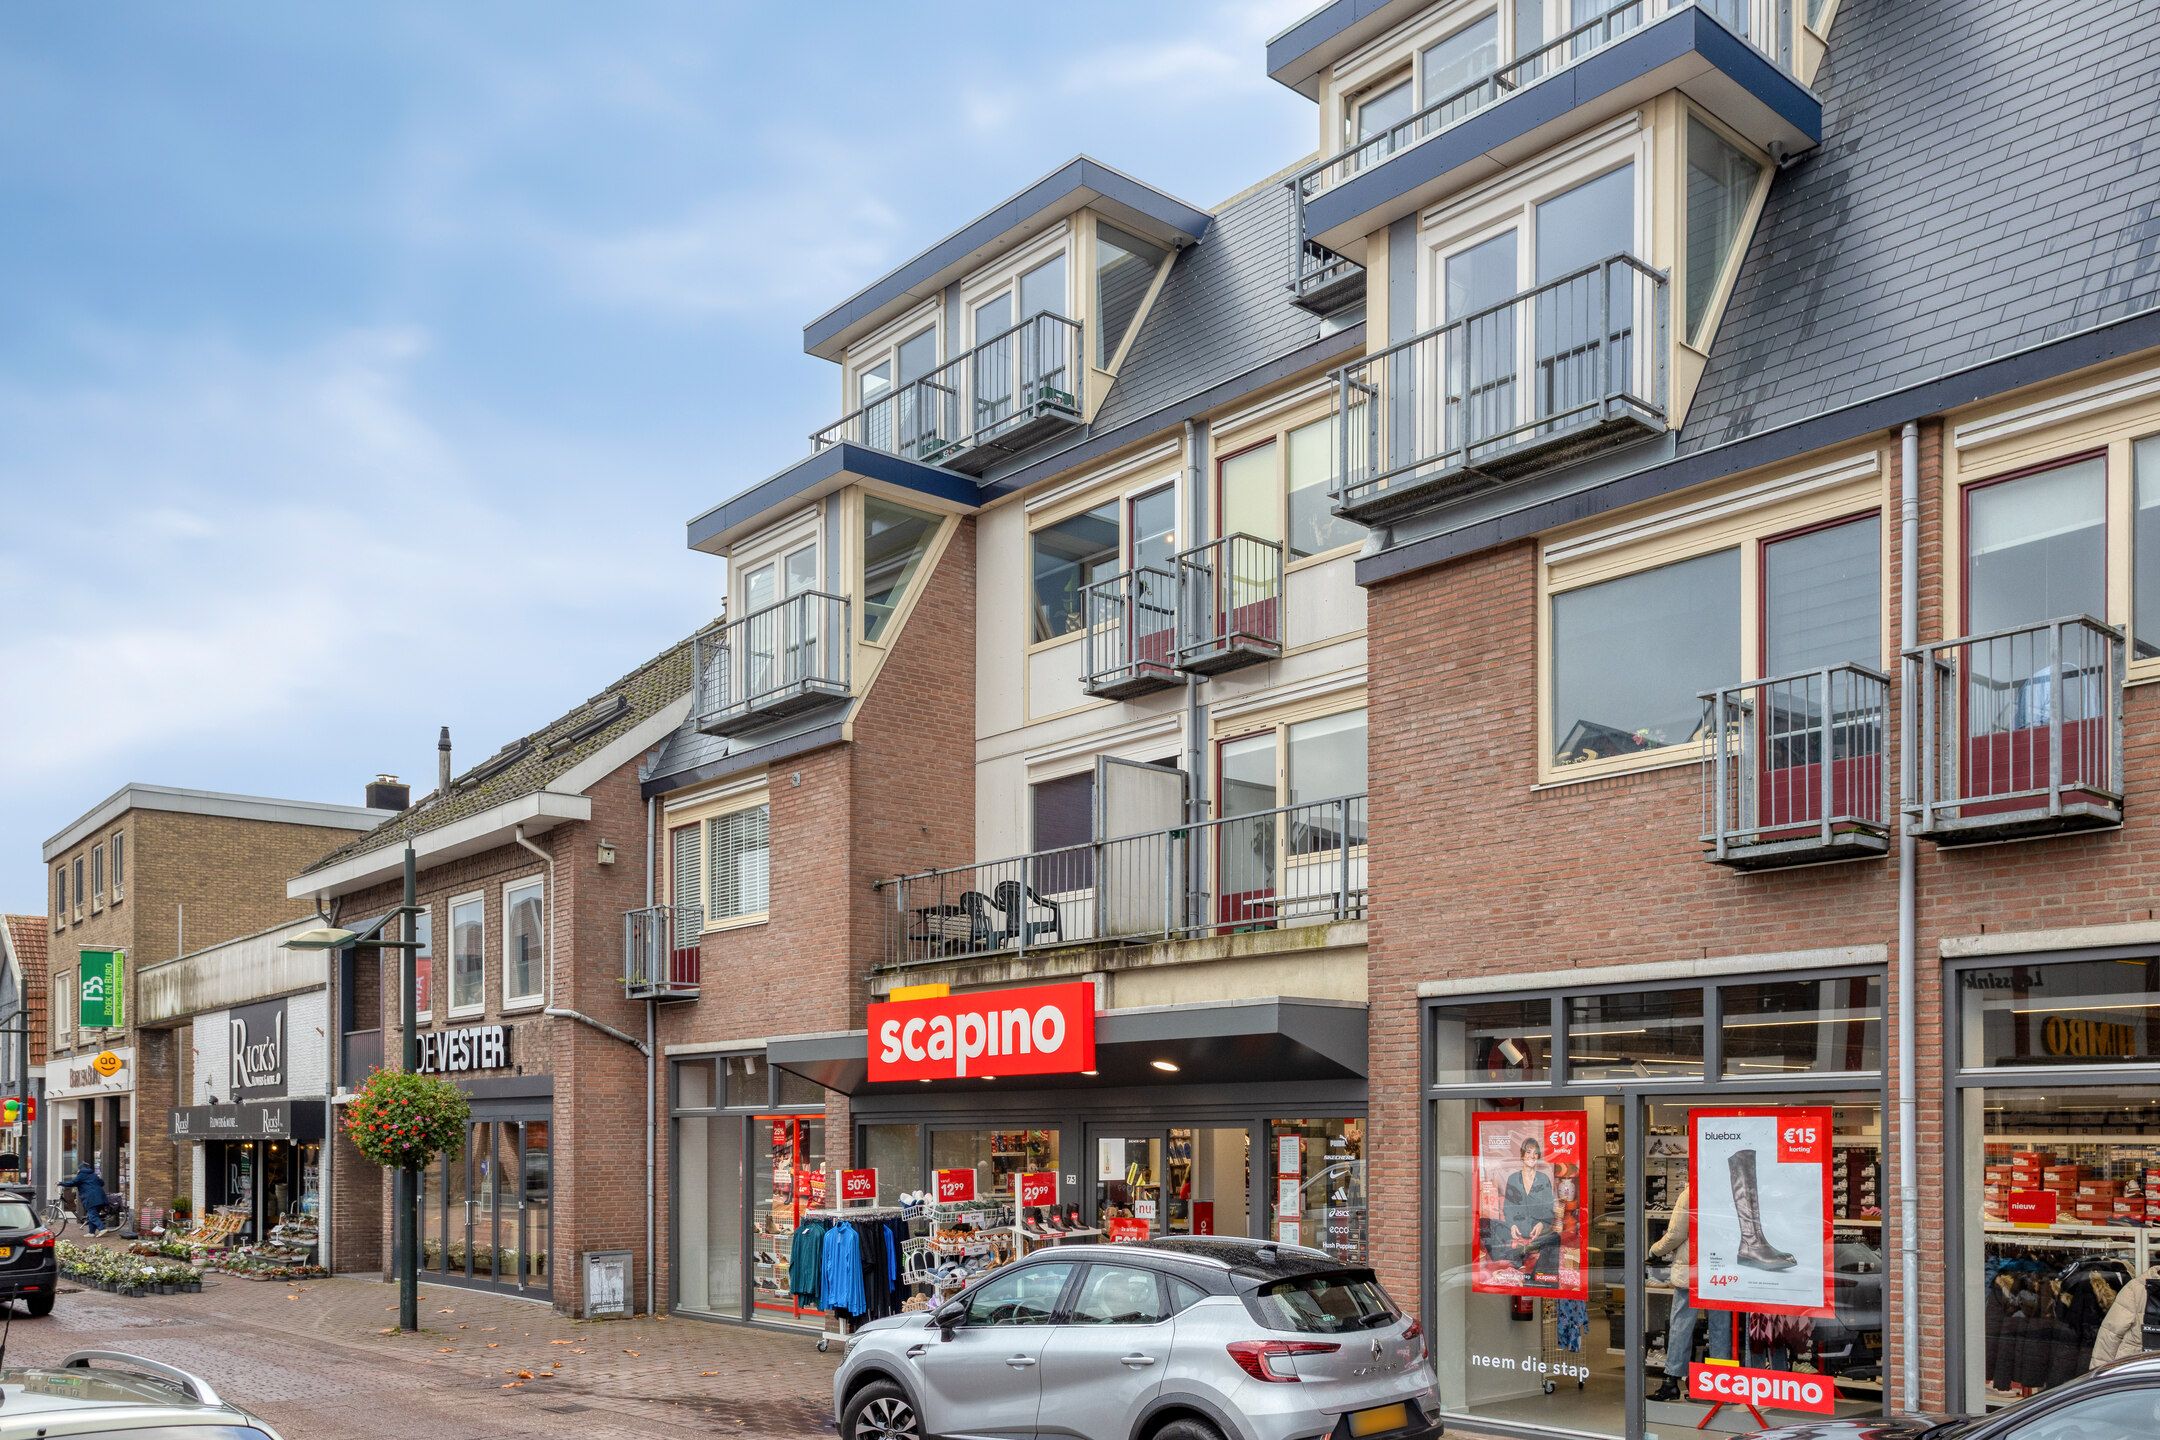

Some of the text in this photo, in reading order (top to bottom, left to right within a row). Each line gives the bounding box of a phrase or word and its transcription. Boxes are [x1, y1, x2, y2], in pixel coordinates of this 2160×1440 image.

[104, 962, 113, 1016] BOEK EN BURO
[436, 1025, 504, 1072] VESTER
[880, 1005, 1066, 1077] scapino
[1550, 1132, 1576, 1145] €10
[1705, 1132, 1741, 1140] bluebox
[1784, 1128, 1816, 1144] €15
[847, 1178, 871, 1190] 50%
[1138, 1204, 1152, 1214] nu
[2012, 1202, 2035, 1210] nieuw
[1472, 1353, 1590, 1380] neem die stap
[1698, 1370, 1823, 1405] scapino
